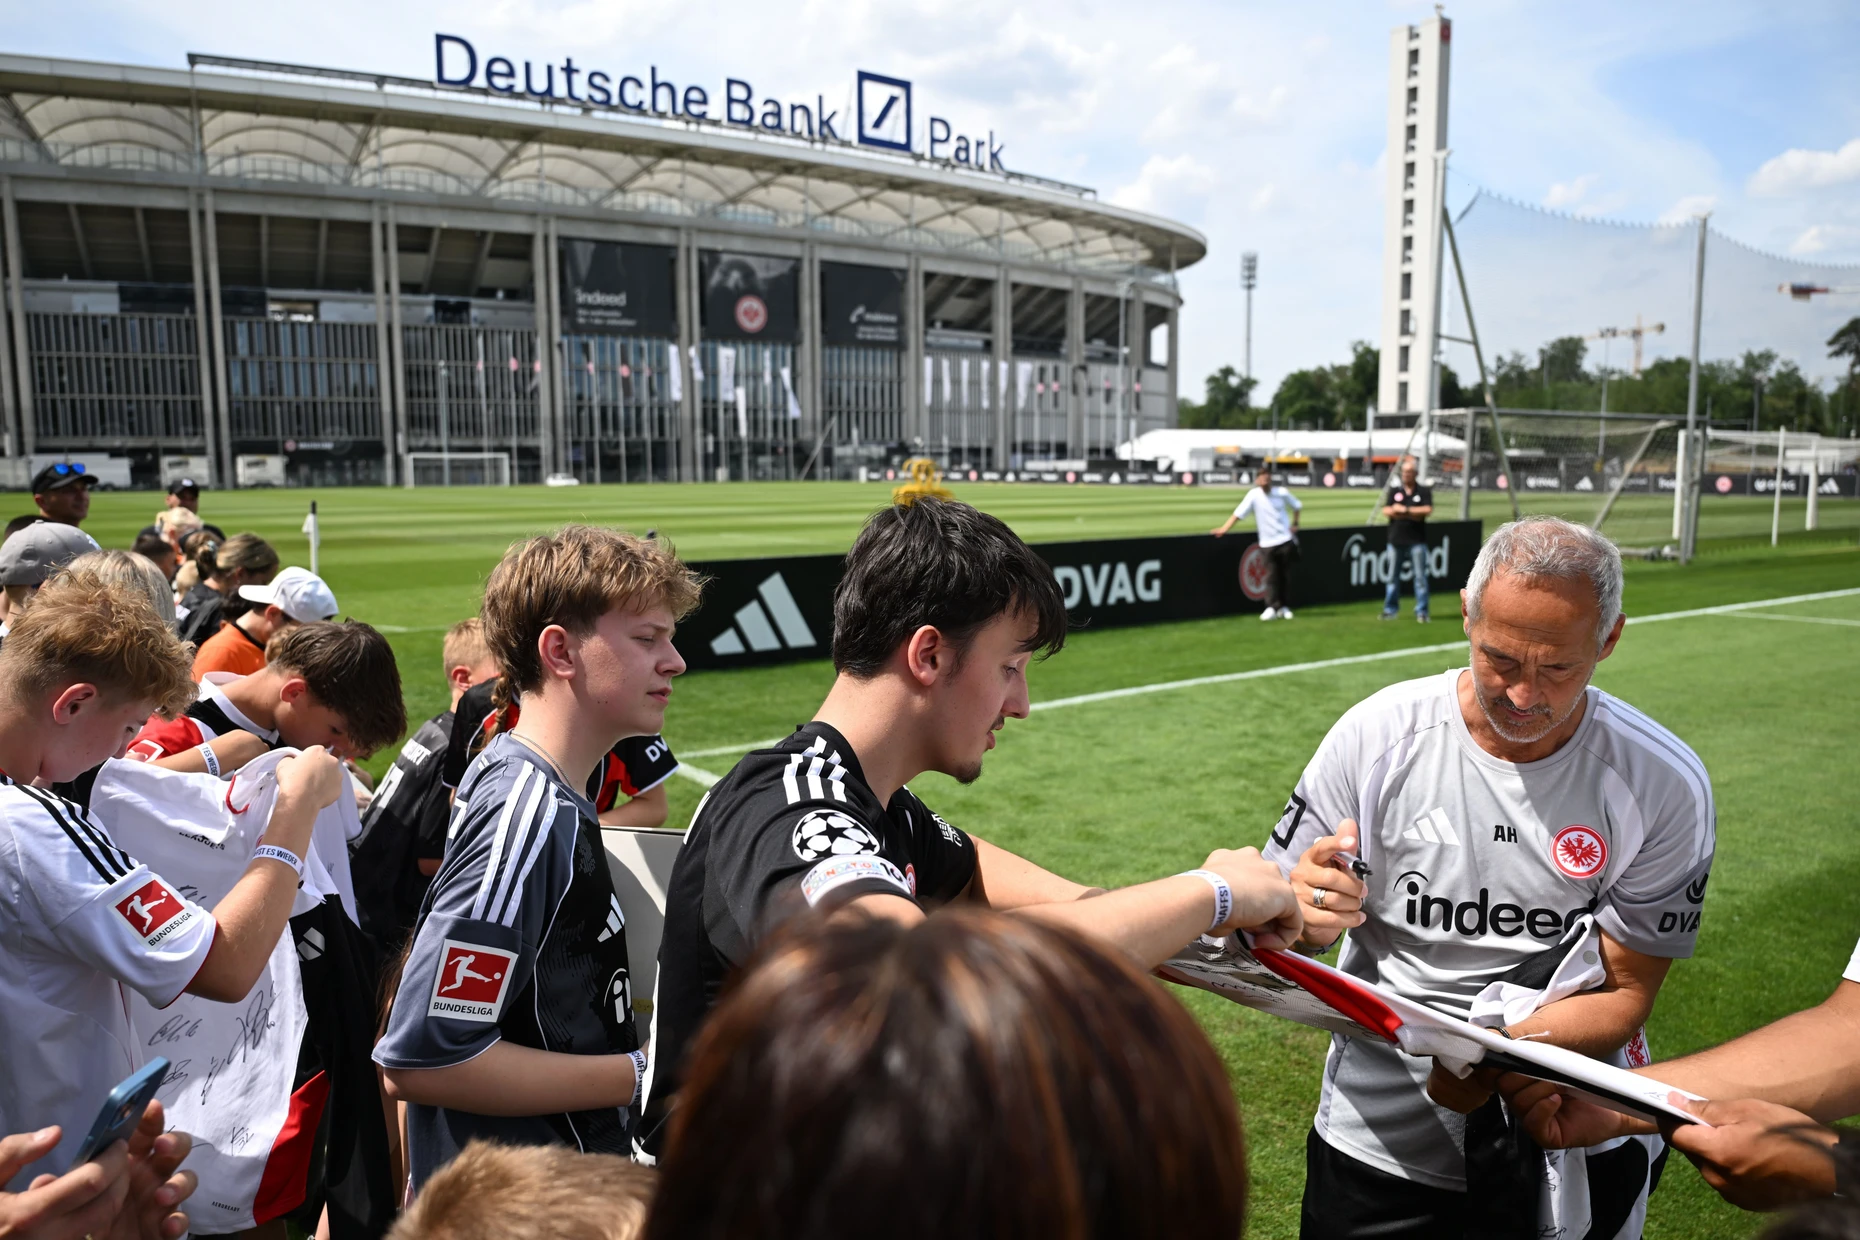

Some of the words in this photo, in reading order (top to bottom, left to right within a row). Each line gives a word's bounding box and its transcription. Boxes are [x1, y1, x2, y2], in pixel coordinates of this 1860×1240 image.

[434, 33, 708, 120] Deutsche
[725, 77, 839, 140] Bank
[930, 117, 1004, 173] Park
[1053, 559, 1161, 610] DVAG
[1493, 825, 1518, 843] AH
[266, 848, 276, 856] ES
[276, 849, 298, 866] WIEDER
[148, 912, 192, 947] BUNDESLIGA
[1657, 911, 1701, 933] DVA
[433, 1002, 493, 1016] BUNDESLIGA
